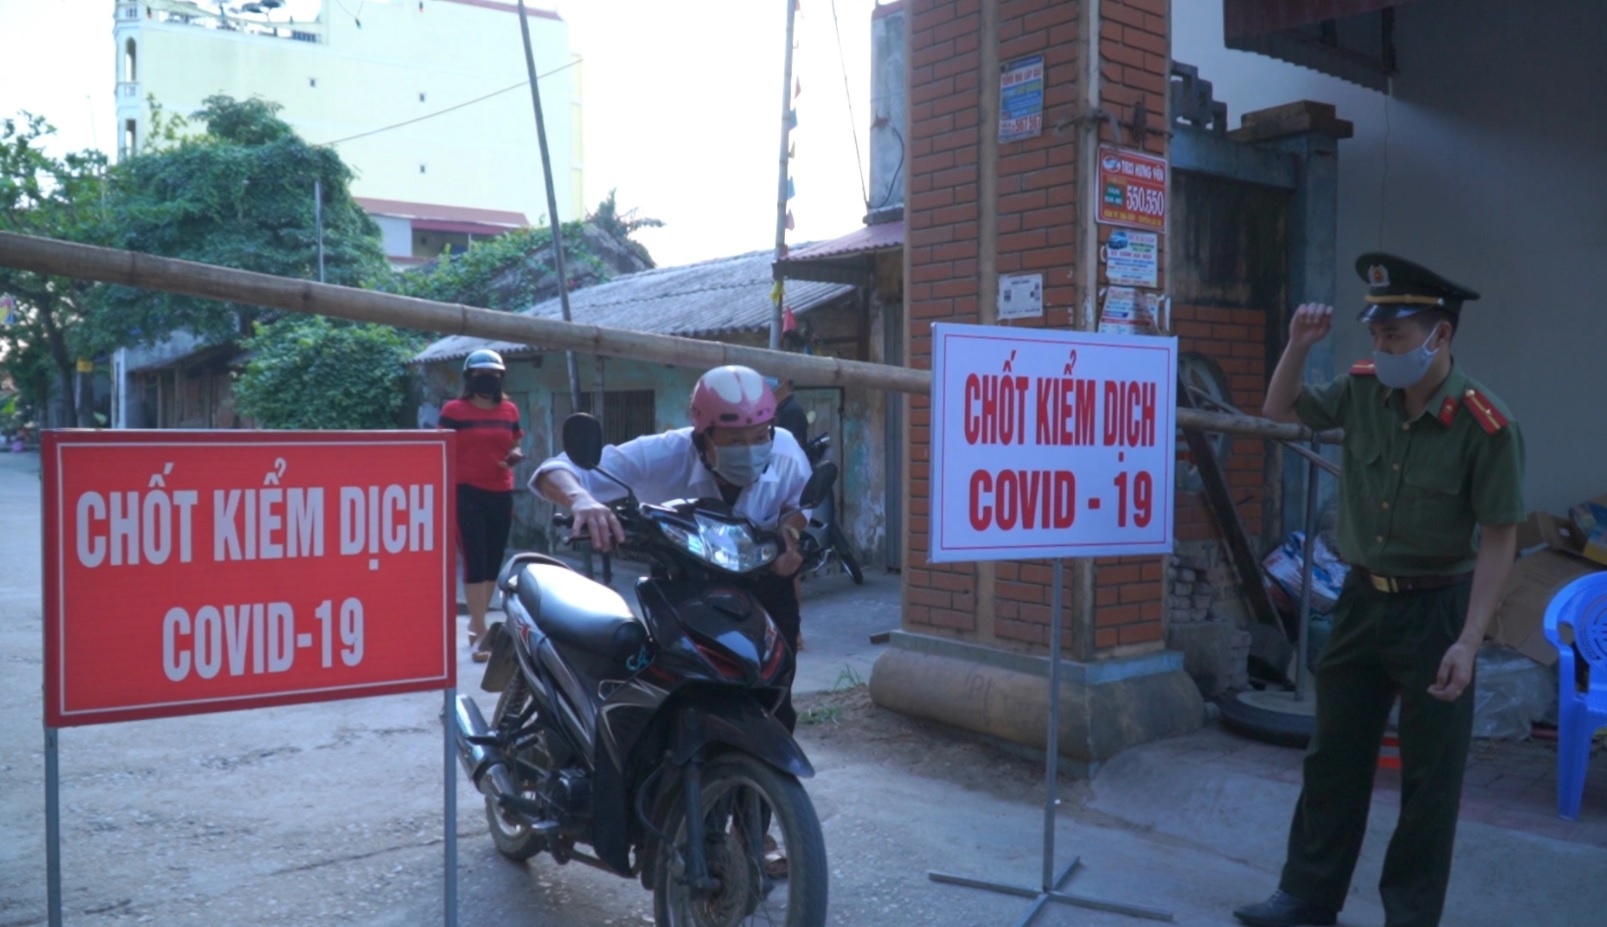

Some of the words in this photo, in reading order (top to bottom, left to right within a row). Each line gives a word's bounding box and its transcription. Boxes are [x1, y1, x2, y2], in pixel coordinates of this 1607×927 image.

[1126, 185, 1164, 216] 550.550
[964, 350, 1029, 446] CHỐT
[1035, 349, 1096, 446] KIỂM
[1103, 380, 1156, 462] DỊCH
[76, 462, 198, 568] CHỐT
[213, 457, 324, 562] KIỂM
[340, 483, 434, 570] DỊCH
[969, 469, 1076, 531] COVID
[1114, 470, 1153, 528] 19
[162, 597, 364, 682] COVID-19
